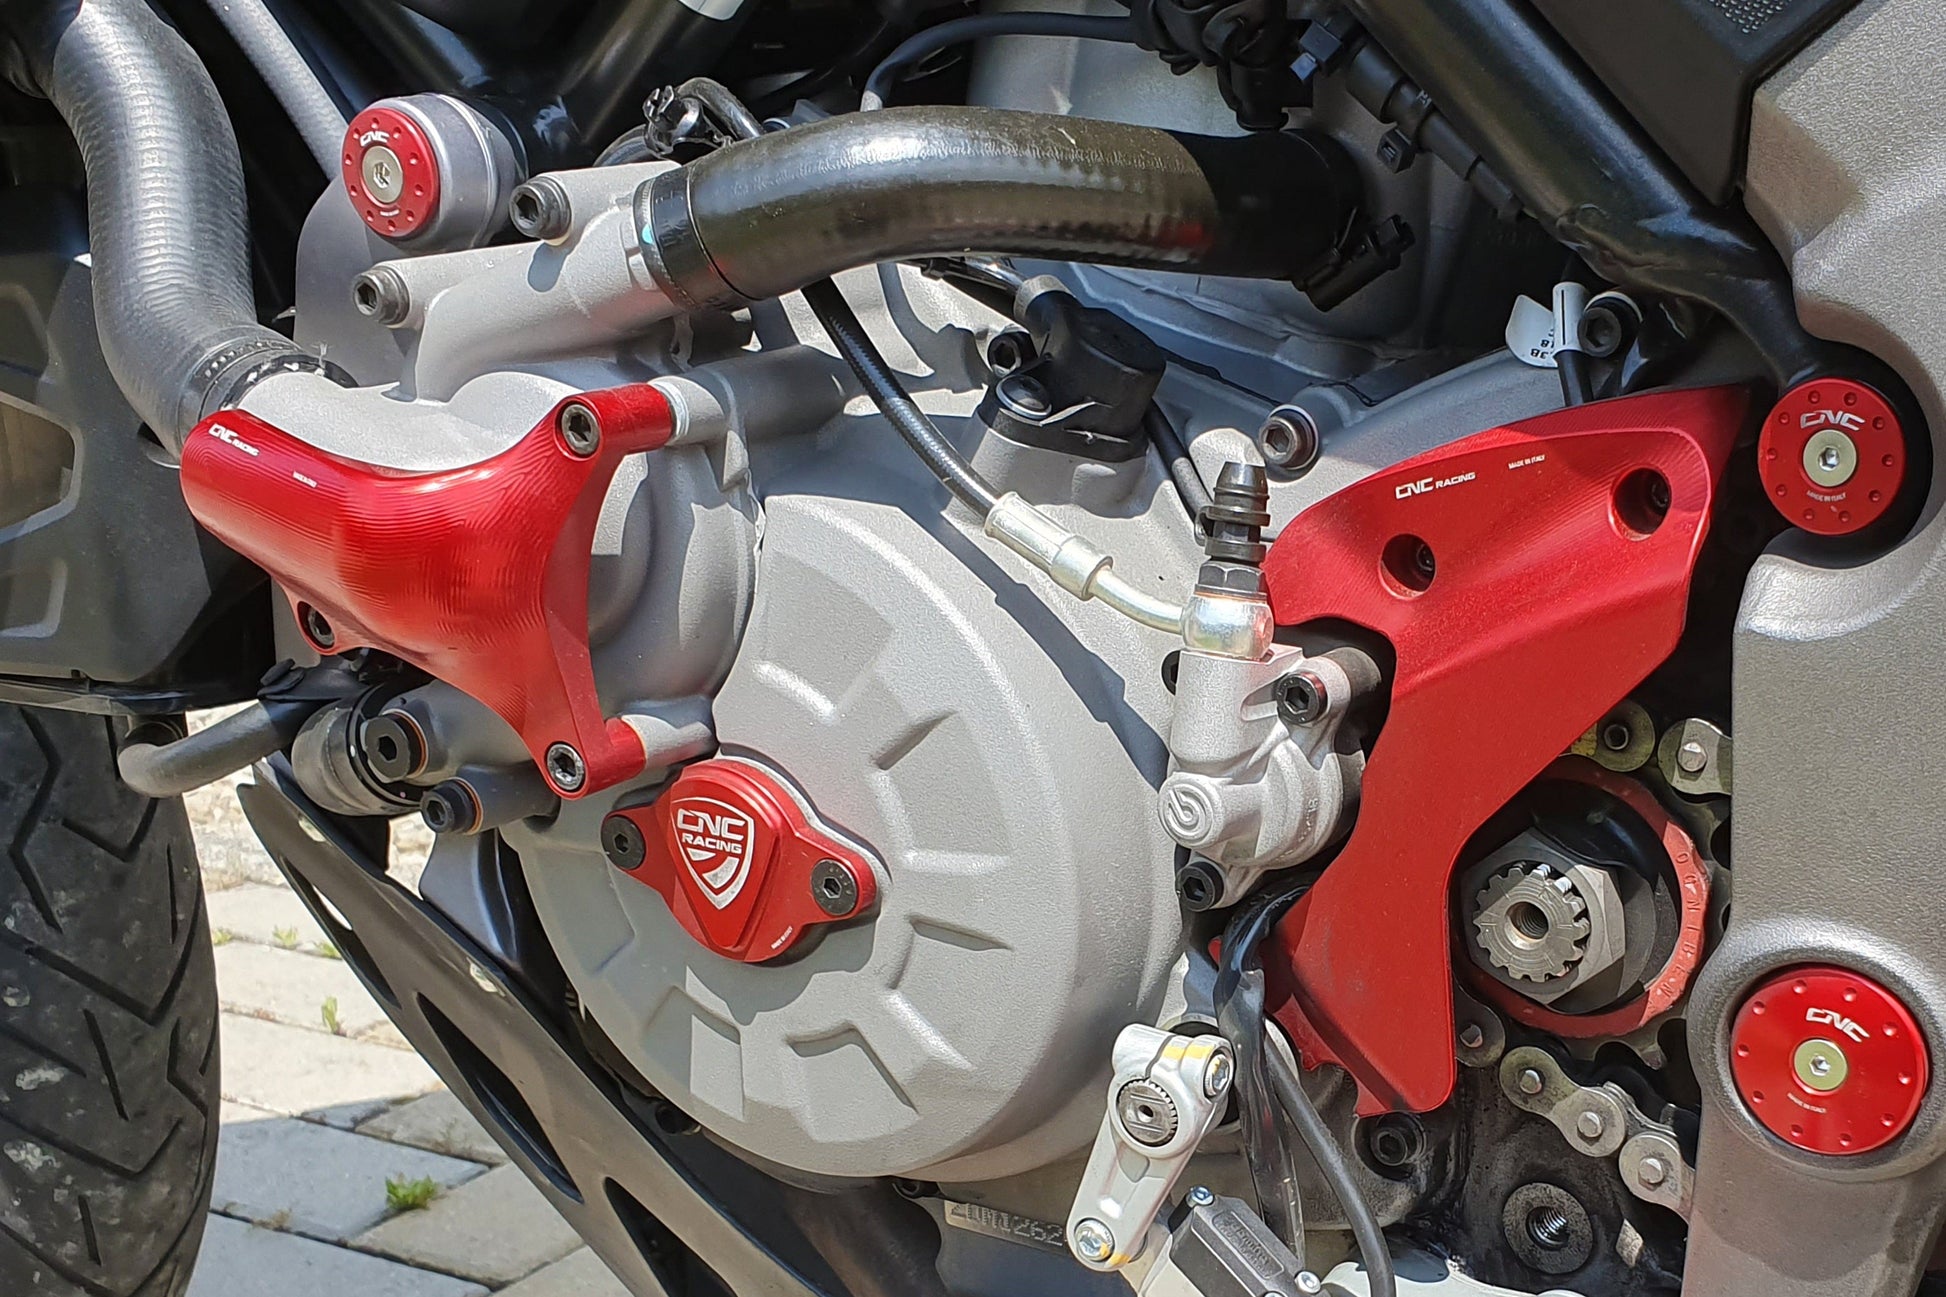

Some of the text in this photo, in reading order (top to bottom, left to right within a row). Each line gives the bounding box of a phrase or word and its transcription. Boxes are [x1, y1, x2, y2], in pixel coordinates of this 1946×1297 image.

[1800, 410, 1865, 431] CNC
[1395, 471, 1476, 499] CNC RACING
[676, 808, 745, 841] CNC
[681, 832, 742, 855] RACING
[1805, 1007, 1870, 1042] CNC
